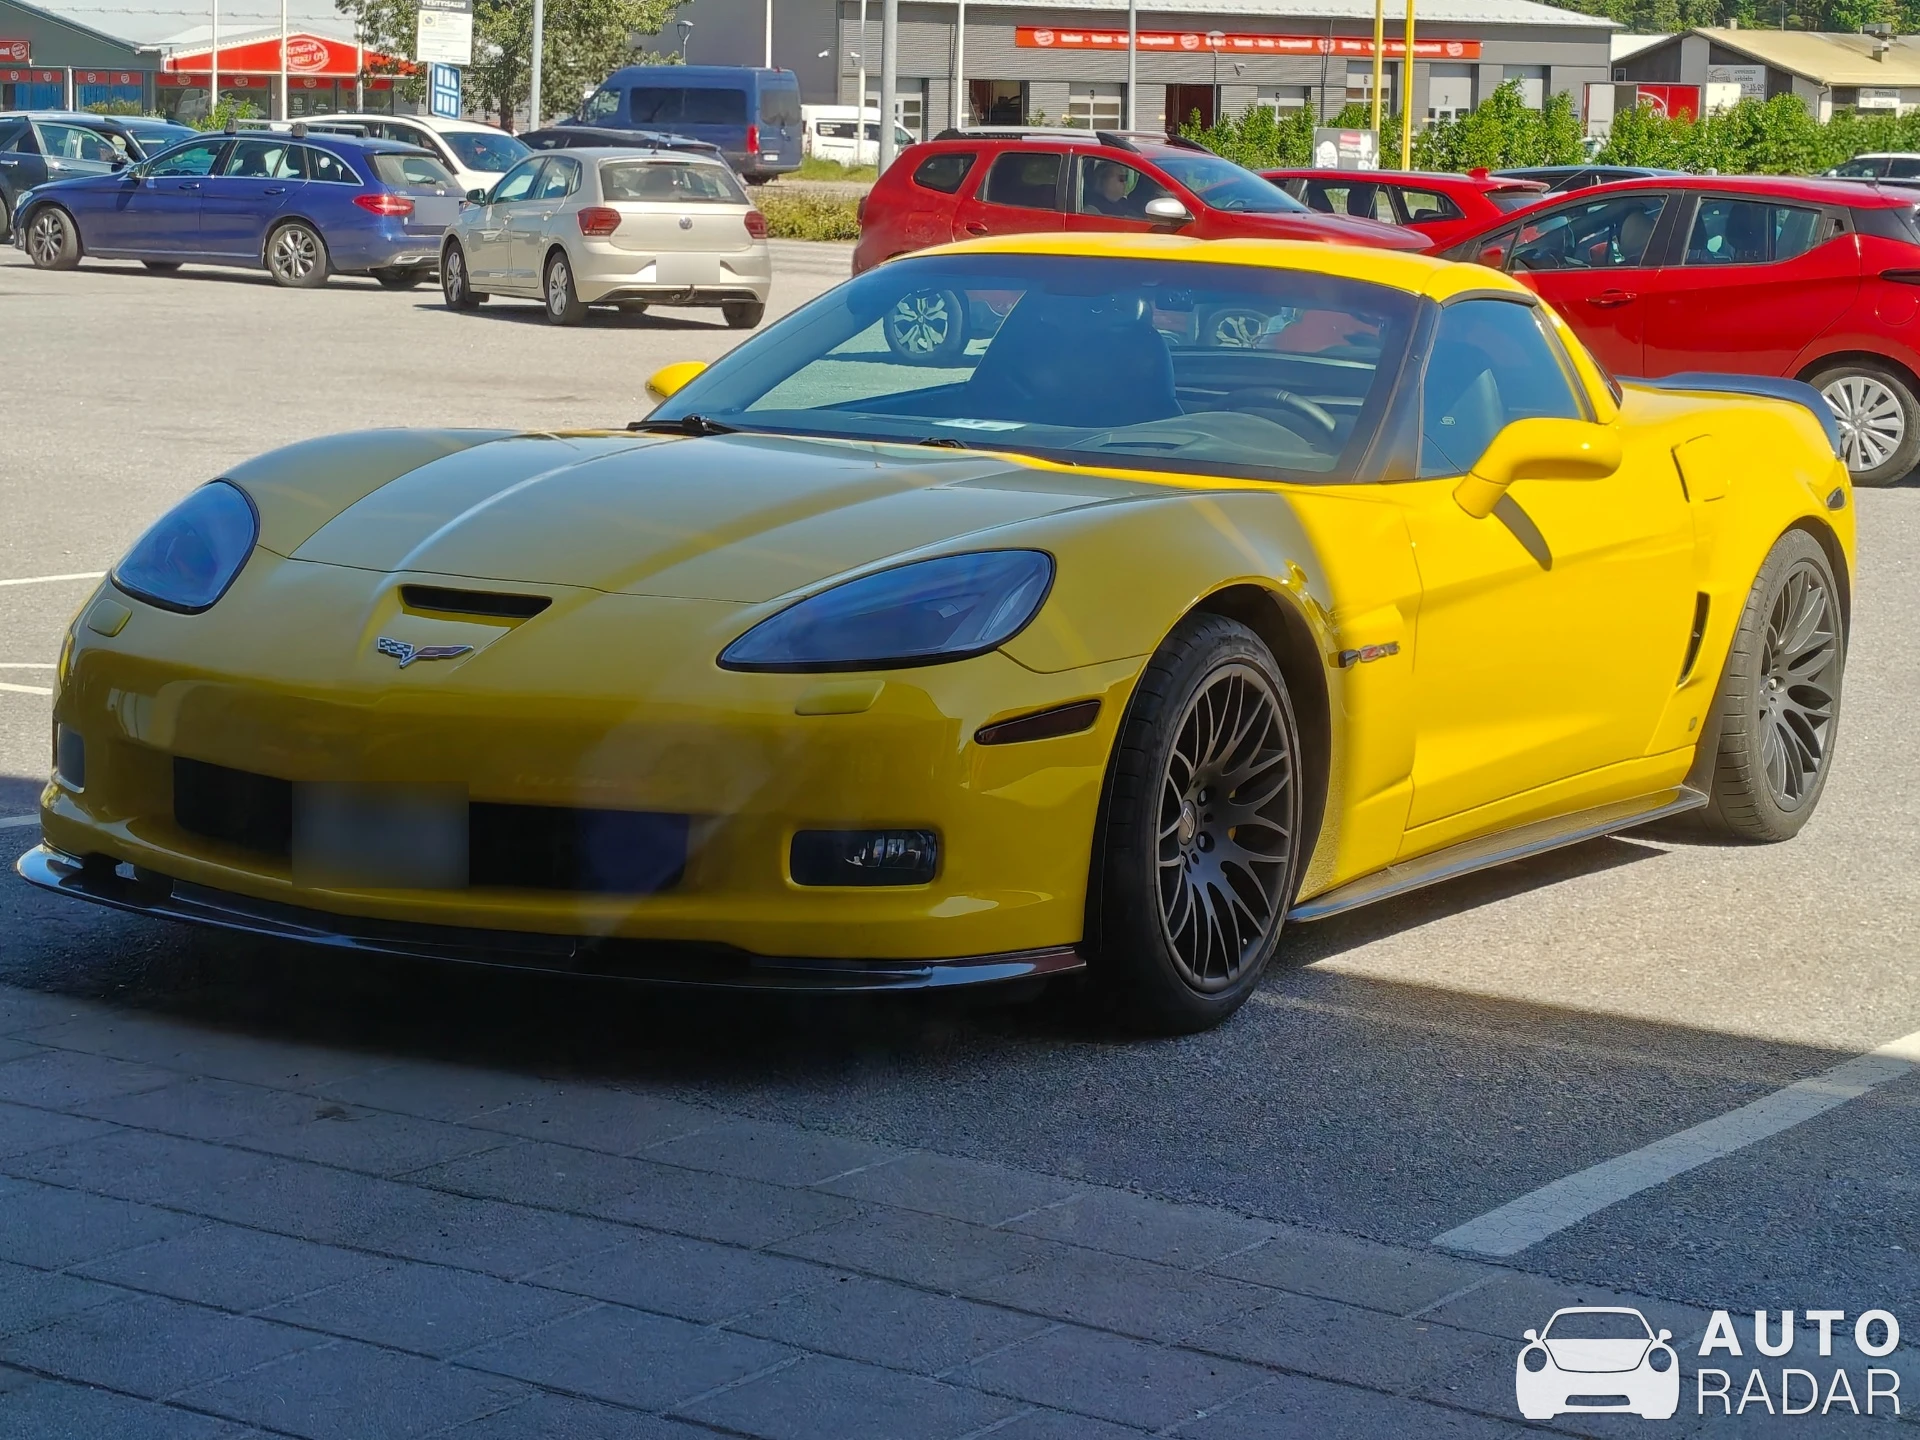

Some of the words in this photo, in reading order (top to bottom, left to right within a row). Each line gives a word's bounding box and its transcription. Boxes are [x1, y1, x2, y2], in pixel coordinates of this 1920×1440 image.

[1089, 89, 1095, 100] 3
[1275, 92, 1280, 103] 5
[1444, 95, 1449, 105] 7
